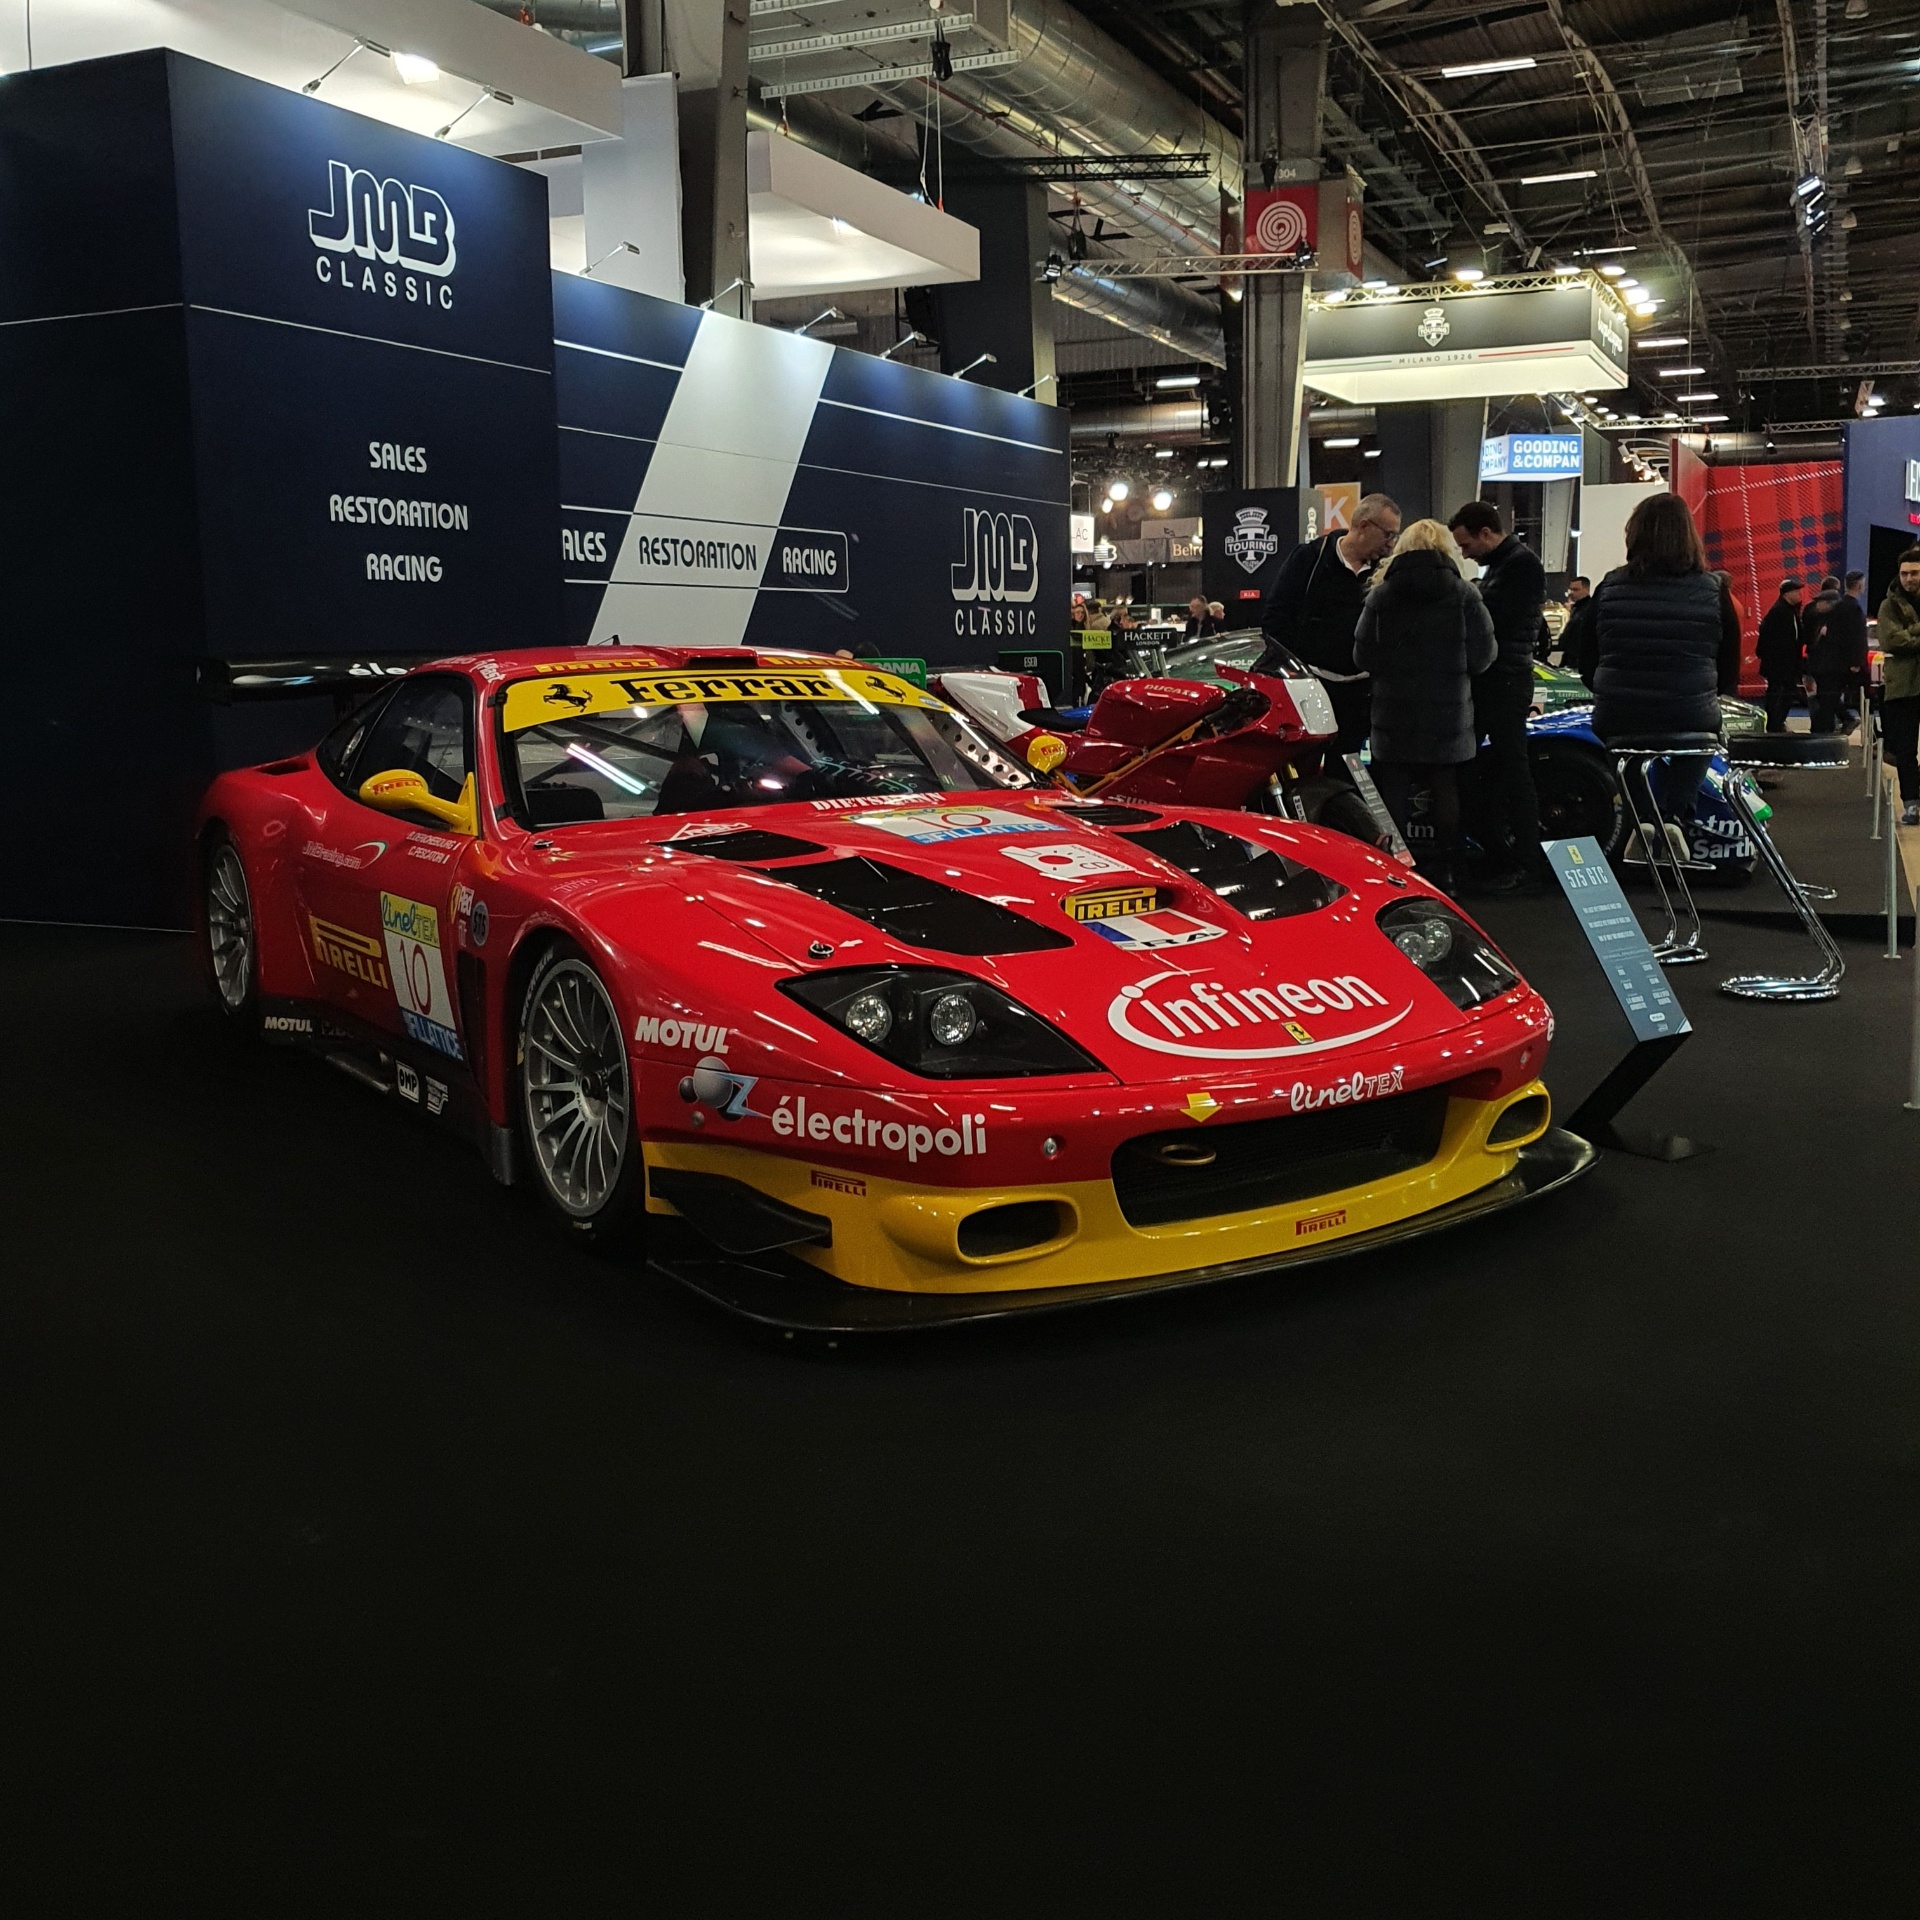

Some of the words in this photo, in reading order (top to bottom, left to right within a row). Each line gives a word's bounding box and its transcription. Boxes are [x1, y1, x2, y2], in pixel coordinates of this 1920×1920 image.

[308, 159, 457, 278] JMB
[316, 256, 453, 310] CLASSIC
[1399, 355, 1441, 365] MILANO
[1447, 353, 1473, 362] 1926
[369, 441, 428, 473] SALES
[1482, 442, 1503, 457] DING
[1513, 440, 1578, 454] GOODING
[1513, 454, 1581, 468] &COMPAN
[329, 494, 469, 531] RESTORATION
[562, 529, 607, 563] ALES
[1071, 527, 1089, 541] AC
[1228, 540, 1275, 553] TOURING
[639, 535, 757, 571] RESTORATION
[782, 546, 837, 575] RACING
[366, 553, 443, 583] RACING
[955, 608, 1036, 635] CLASSIC
[1124, 631, 1172, 642] HACKETT
[1227, 659, 1257, 668] HOLD
[610, 671, 855, 705] Ferrar
[907, 812, 992, 830] 10
[1565, 867, 1588, 889] 575
[1589, 865, 1609, 886] GTC
[1065, 886, 1157, 922] PIRELLI
[308, 915, 389, 990] PIRELLI
[400, 939, 432, 1016] 10
[264, 1016, 313, 1032] MOTUL
[635, 1015, 729, 1053] MOTUL
[771, 1096, 987, 1163] électropoli
[811, 1169, 867, 1197] PIRELLI
[1295, 1209, 1347, 1236] PIRELLI
